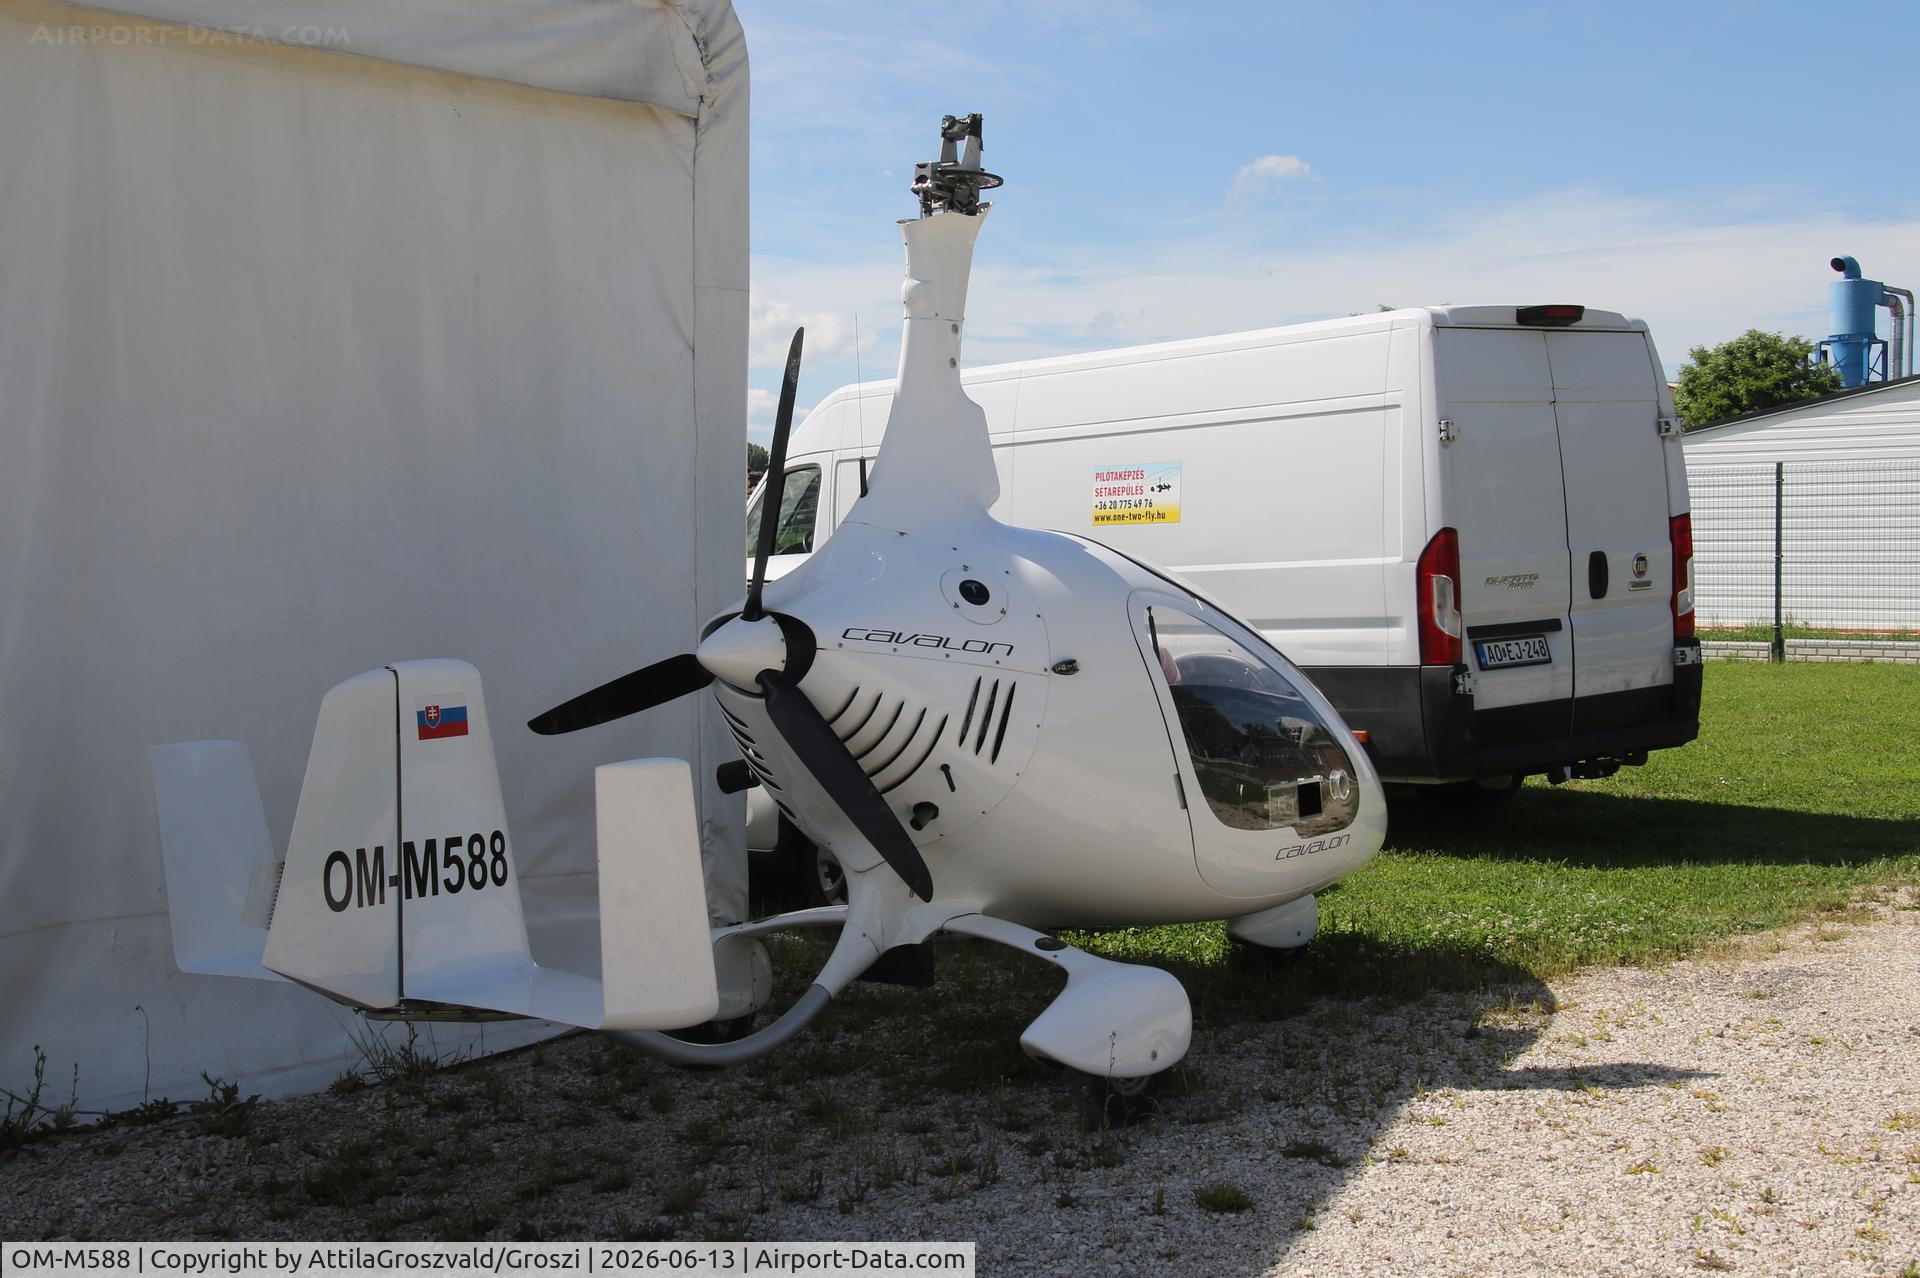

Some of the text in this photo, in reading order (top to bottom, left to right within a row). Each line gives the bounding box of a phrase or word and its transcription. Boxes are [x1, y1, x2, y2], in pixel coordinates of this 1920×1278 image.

[1095, 467, 1145, 482] PILÓTAKÉPZÉS
[1094, 483, 1144, 497] SÉTAREPÜLÉS
[1094, 499, 1153, 510] +36 20 775 49 76
[1094, 510, 1166, 522] www.one-two-fly.hu
[323, 830, 508, 912] OM-M588
